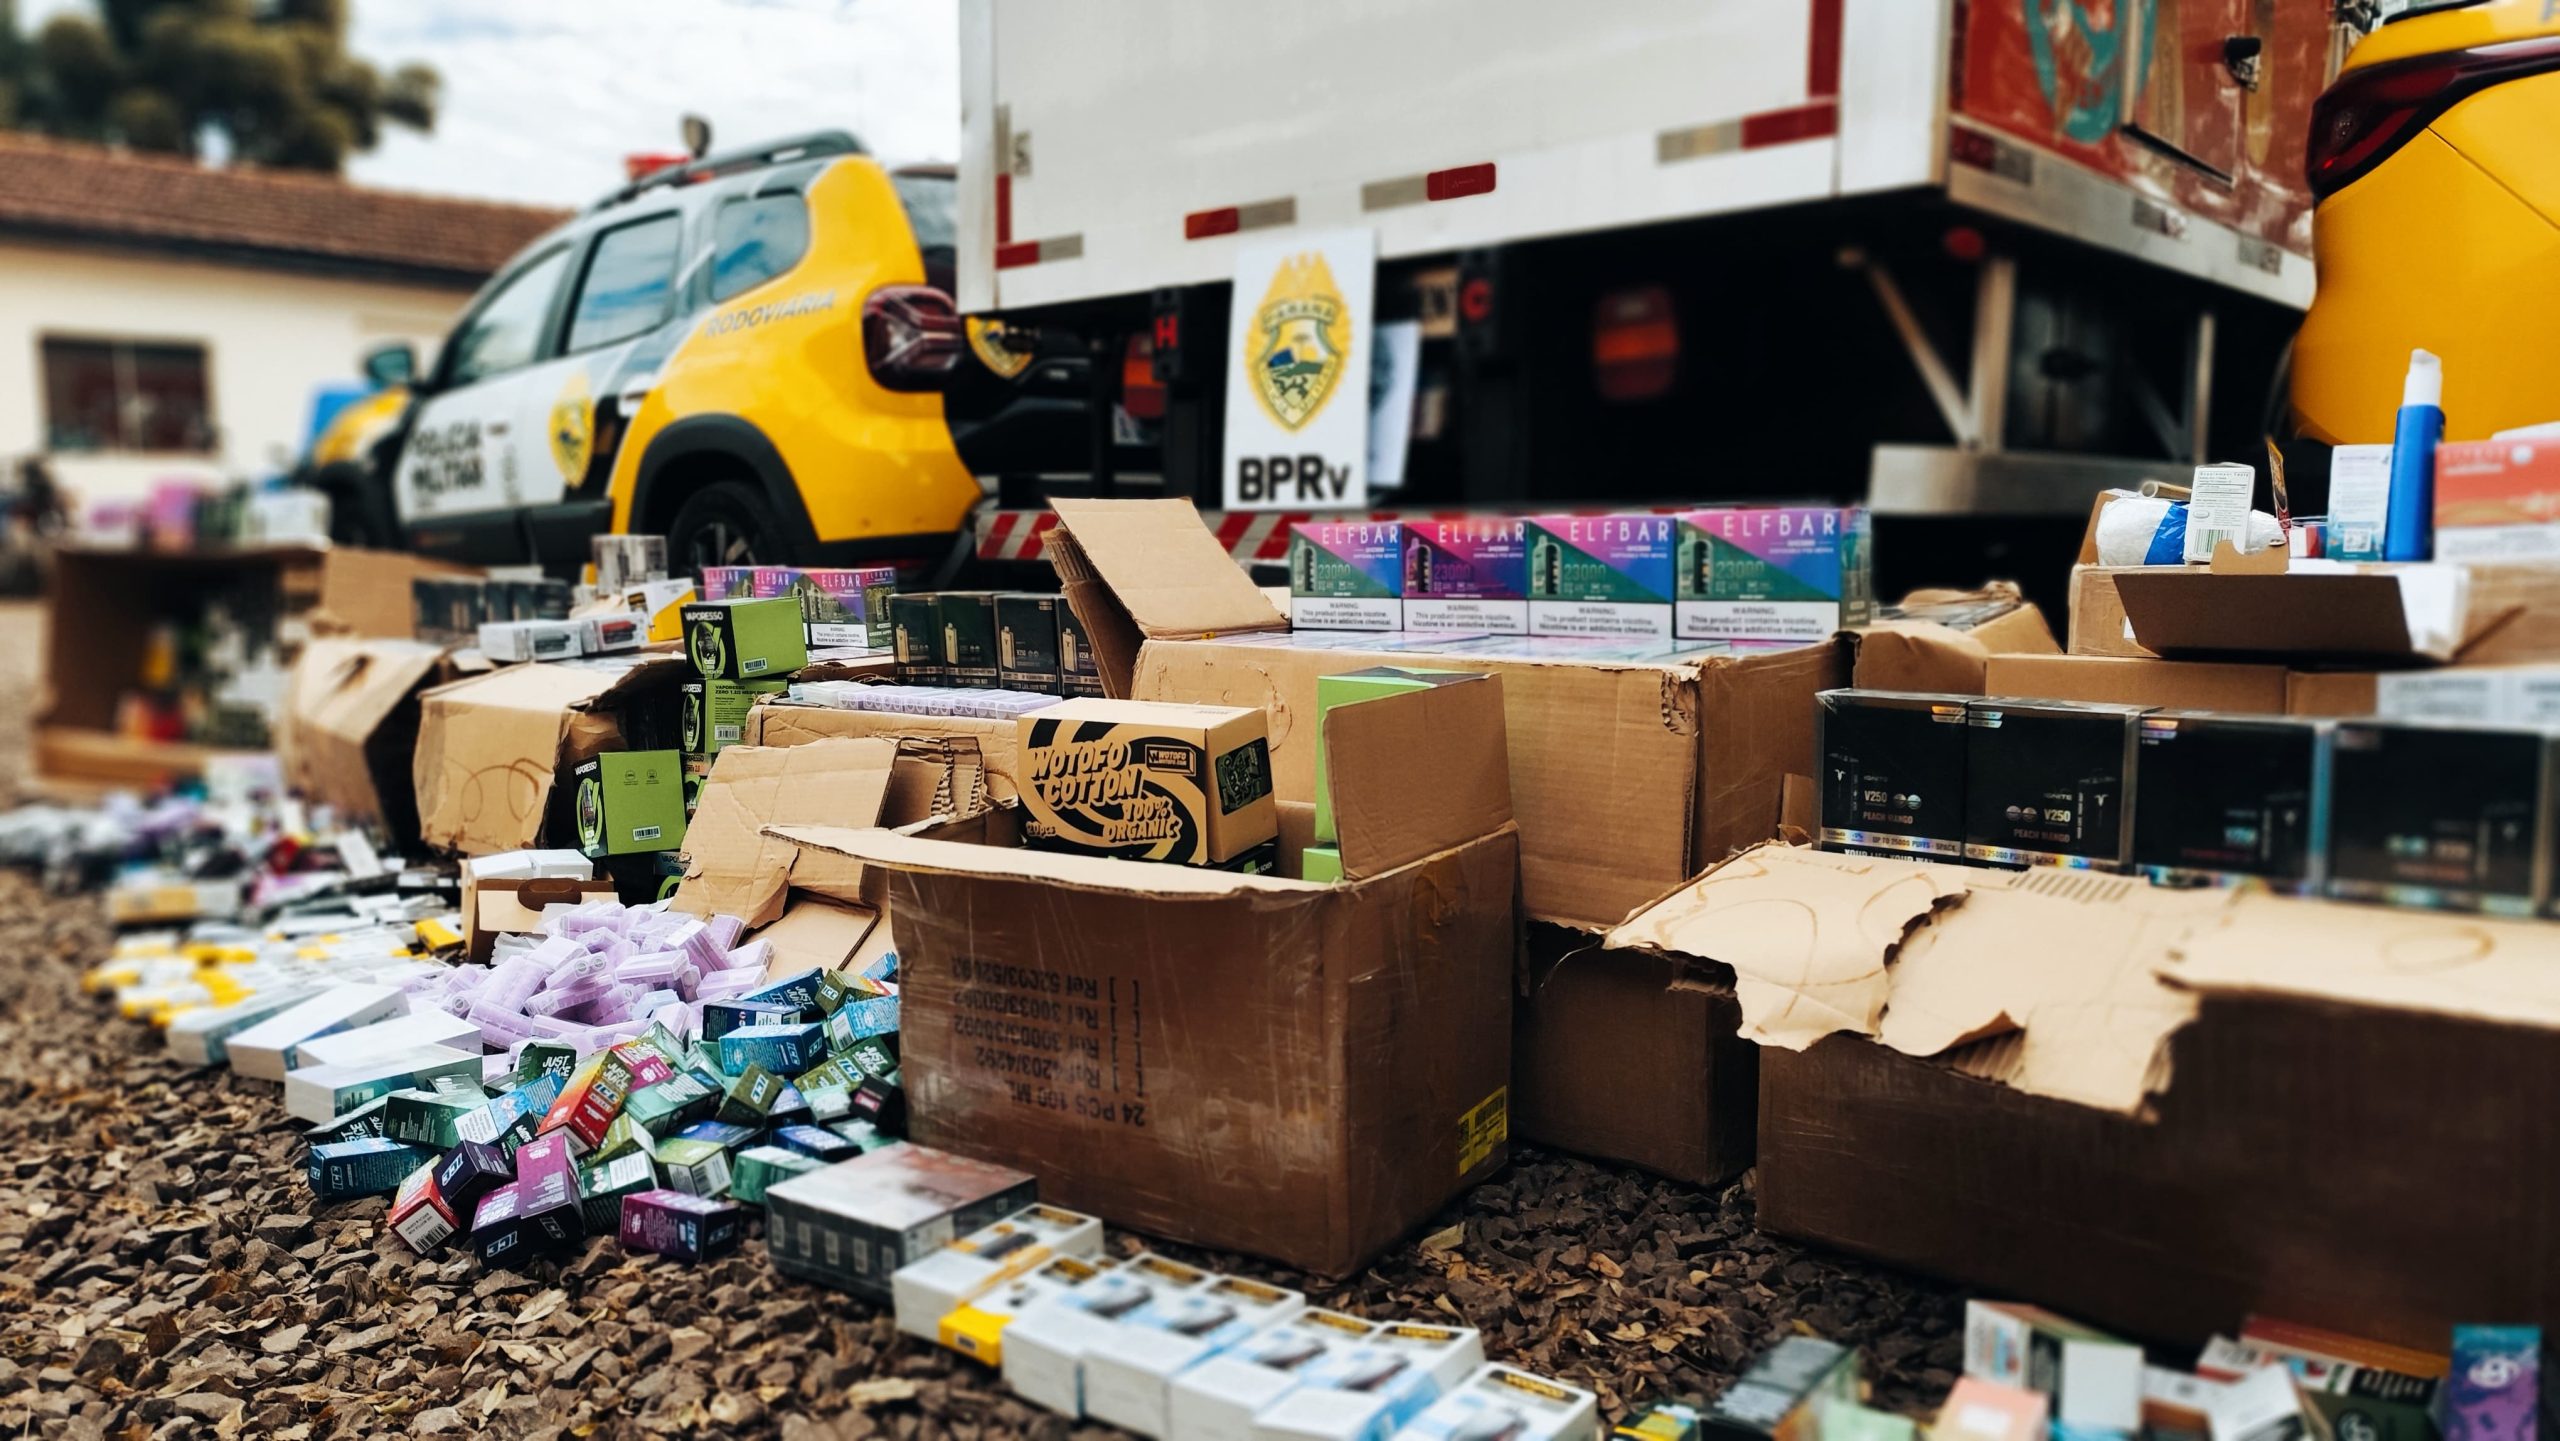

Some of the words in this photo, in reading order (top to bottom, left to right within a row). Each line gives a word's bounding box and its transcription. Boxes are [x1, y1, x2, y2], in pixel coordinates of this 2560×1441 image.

[1238, 455, 1350, 502] BPRv
[1322, 525, 1398, 545] ELFBAR
[1570, 520, 1669, 542] ELFBAR
[1723, 513, 1835, 537] ELFBAR
[755, 571, 789, 586] ELFBAR
[821, 574, 861, 588] ELFBAR
[685, 611, 723, 621] VAPORESSO
[1032, 742, 1125, 781] WOTOFO
[1048, 767, 1141, 806] COTTON
[1864, 790, 1887, 803] V250
[1125, 799, 1171, 822] 100%
[2044, 808, 2071, 822] V250
[1108, 818, 1180, 843] ORGANIC
[542, 1055, 571, 1068] JUST
[864, 1045, 888, 1065] JUST
[603, 1070, 629, 1091] JUICE
[606, 1062, 632, 1080] JUST
[836, 1057, 864, 1082] ICE
[592, 1081, 620, 1104] ICE
[1123, 1104, 1146, 1127] 24
[442, 1152, 464, 1187] ICE
[486, 1231, 518, 1258] ICE
